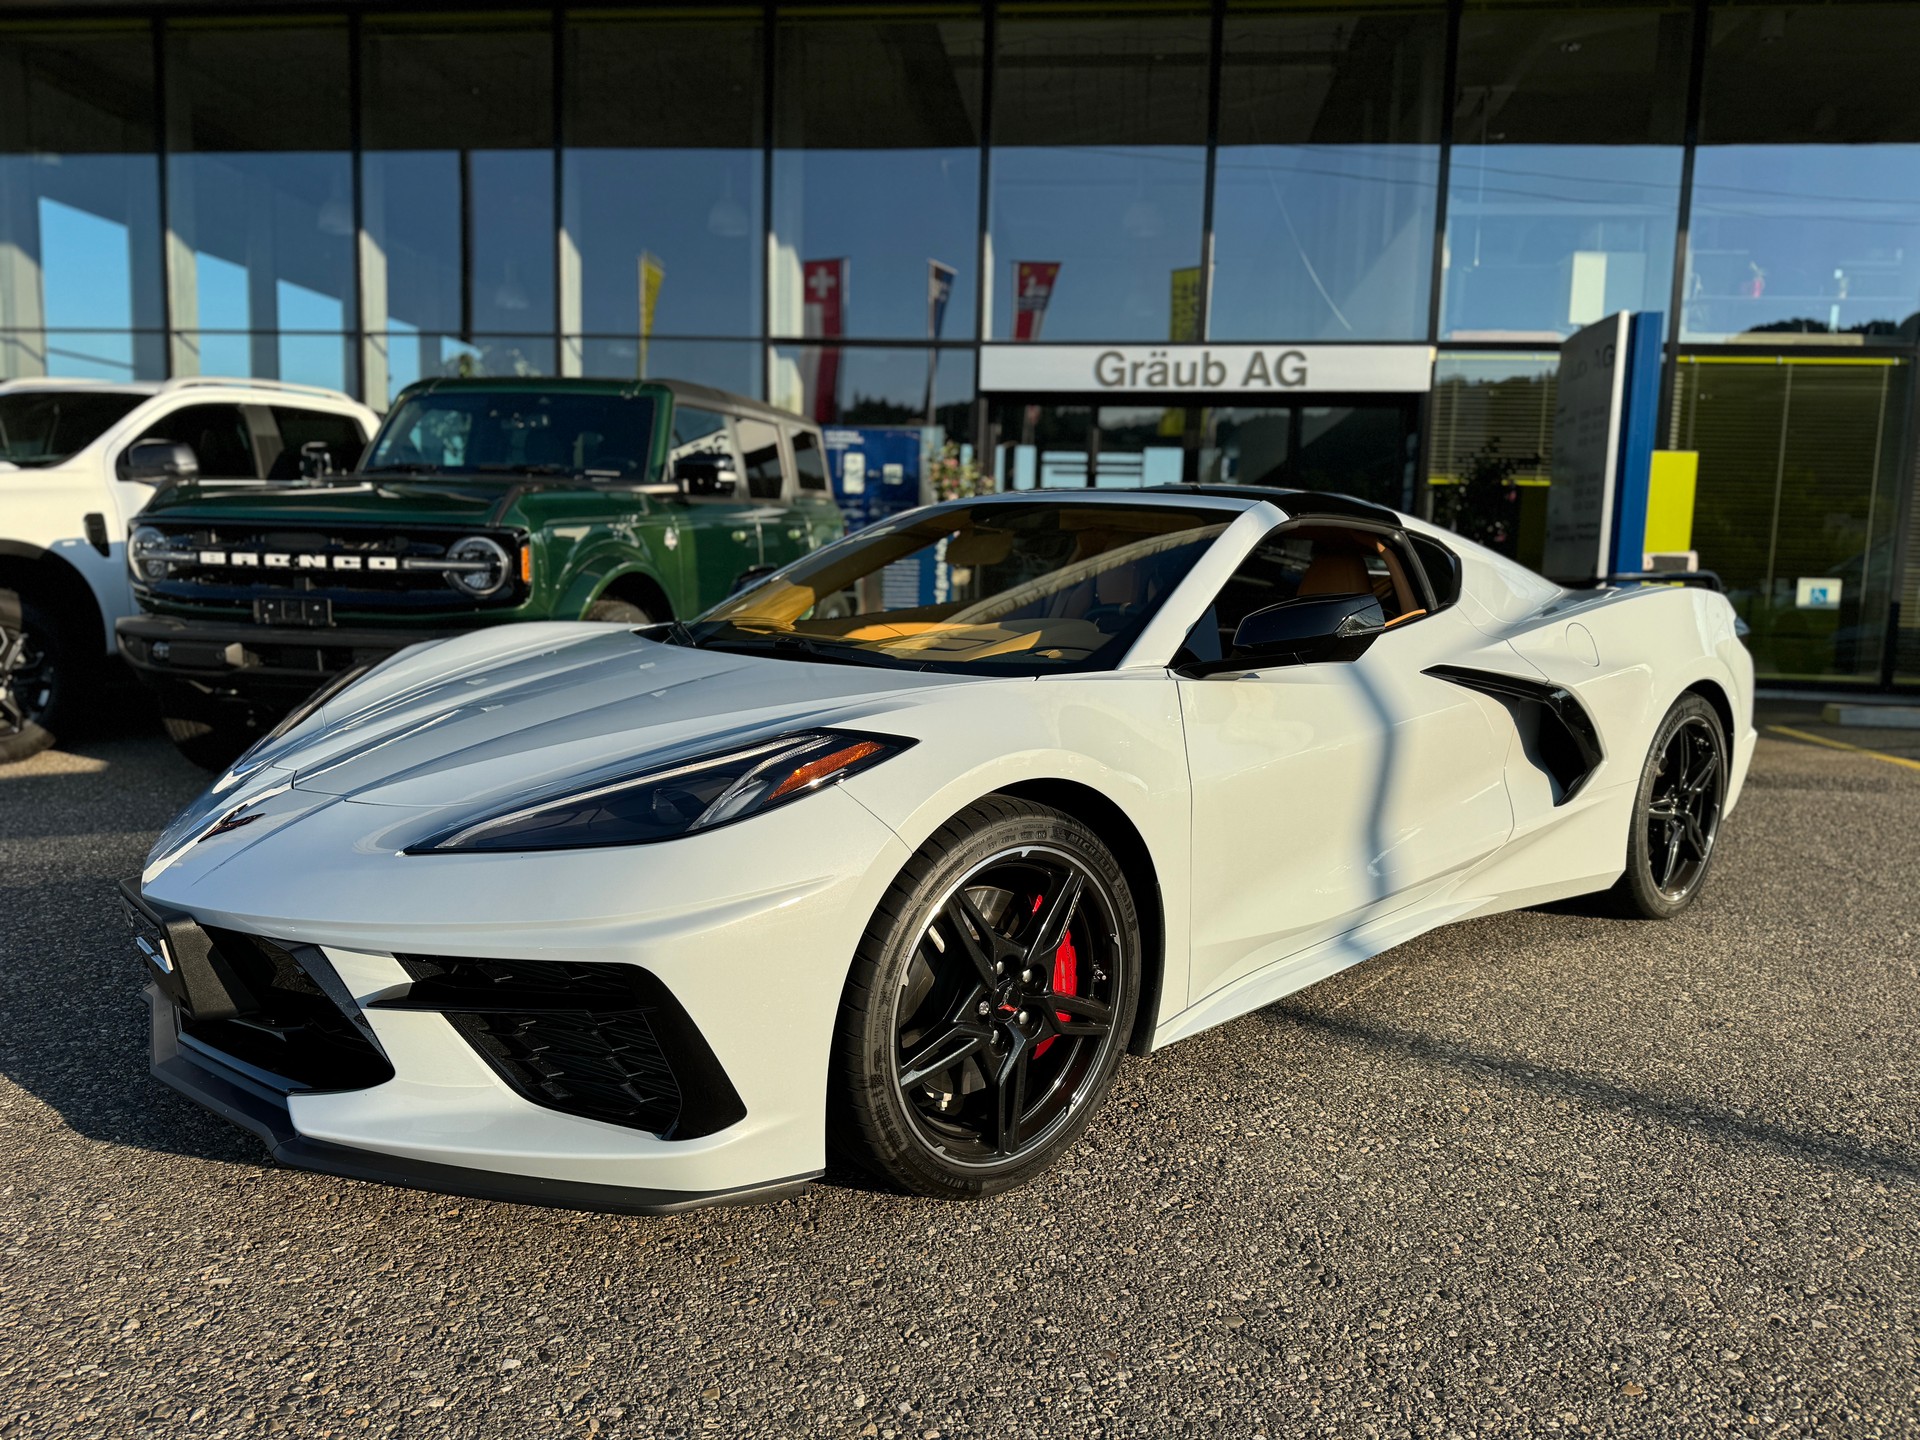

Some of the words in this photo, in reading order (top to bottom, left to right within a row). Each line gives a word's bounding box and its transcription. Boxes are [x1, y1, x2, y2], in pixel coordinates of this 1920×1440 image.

[1094, 351, 1227, 387] Gräub
[1240, 351, 1308, 387] AG
[200, 551, 397, 570] BRONCO
